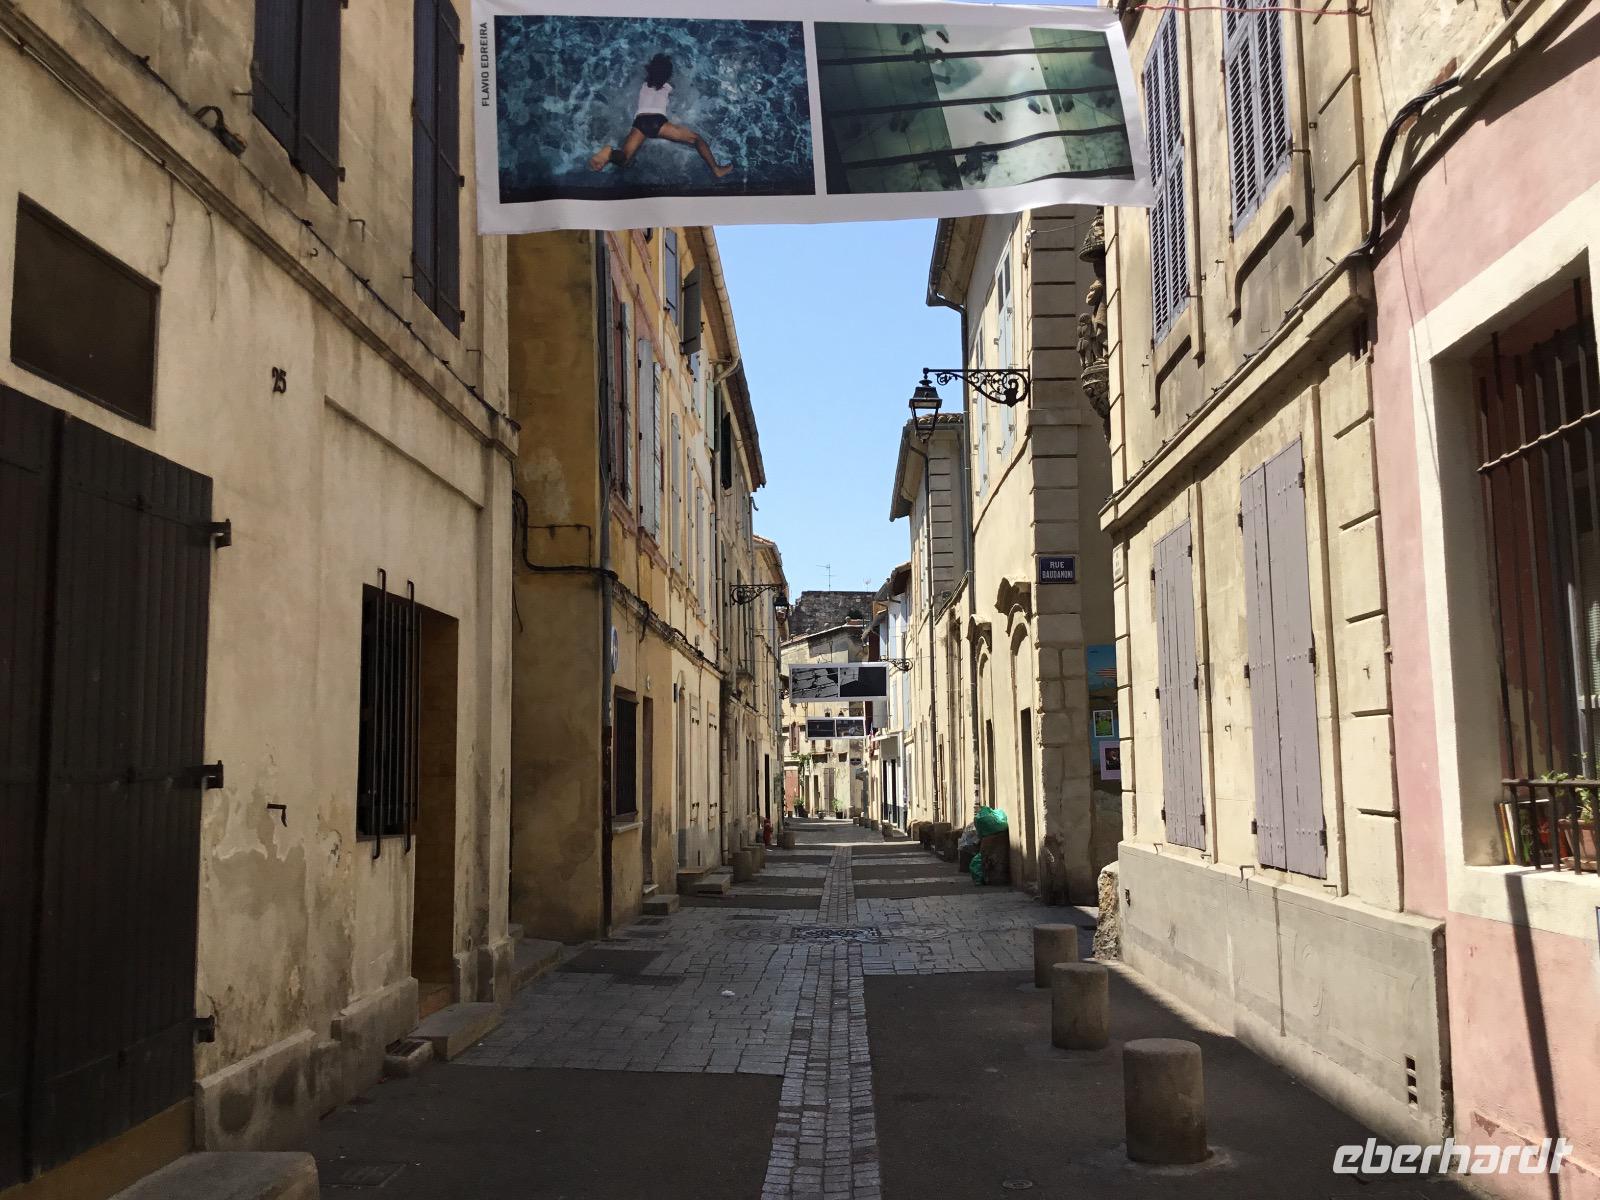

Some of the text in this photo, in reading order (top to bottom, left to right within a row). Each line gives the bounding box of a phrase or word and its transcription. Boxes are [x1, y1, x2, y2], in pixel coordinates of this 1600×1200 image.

[480, 22, 490, 107] FLAVIO EDREIRA
[272, 366, 287, 394] 25
[1049, 561, 1065, 569] RUE
